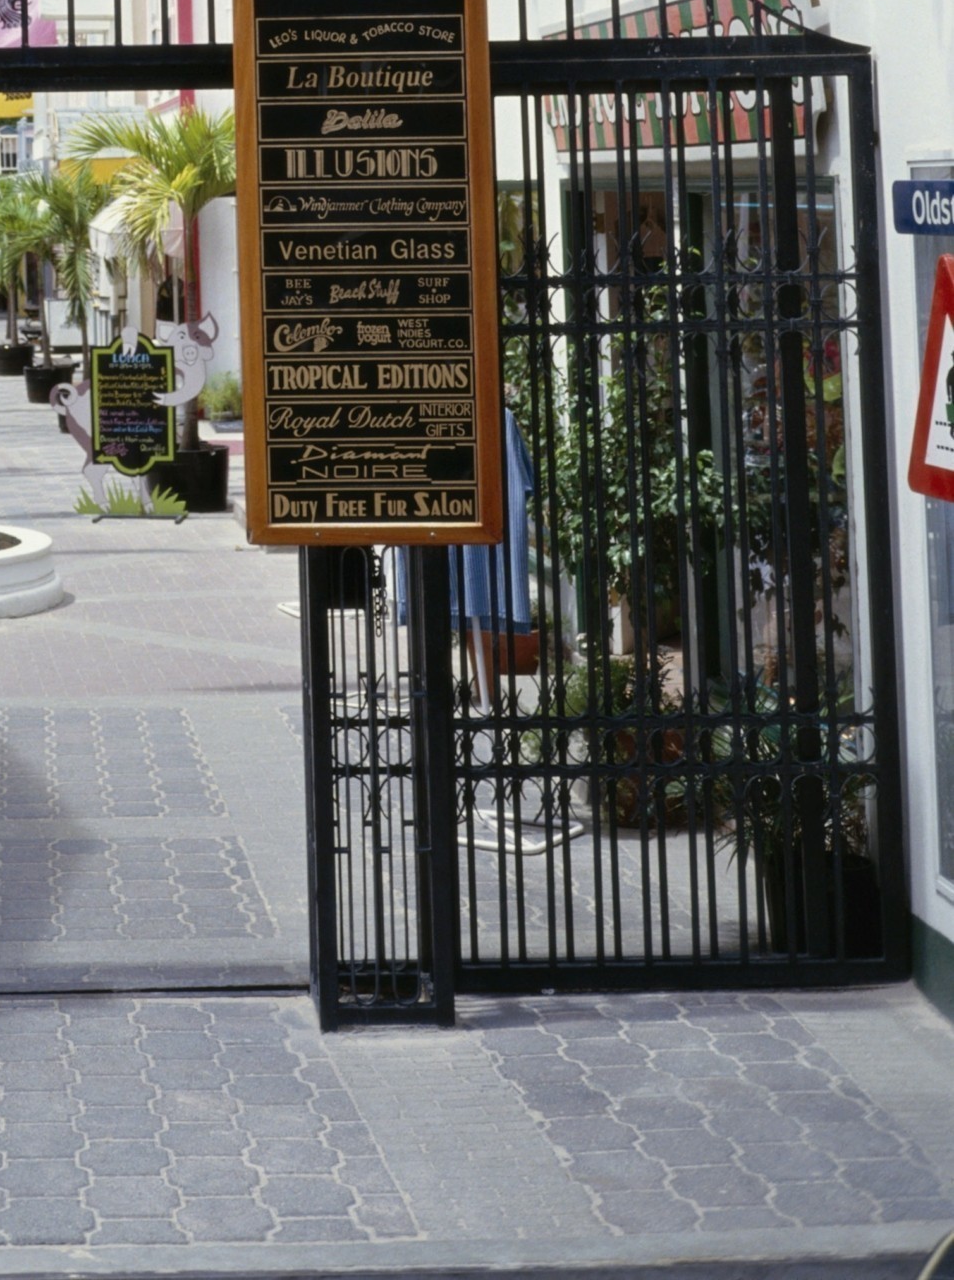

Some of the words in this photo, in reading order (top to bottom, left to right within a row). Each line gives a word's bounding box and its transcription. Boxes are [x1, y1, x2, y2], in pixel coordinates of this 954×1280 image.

[268, 28, 298, 49] LEO'S
[304, 29, 347, 44] LIQUOR
[350, 34, 358, 44] &
[362, 22, 414, 42] TOBACCO
[418, 25, 456, 43] STORE
[286, 66, 318, 89] La
[327, 65, 434, 93] Boutique
[285, 148, 439, 178] ILLUSIONS
[297, 197, 368, 220] Windjammer
[369, 197, 414, 216] Clothing
[416, 197, 466, 221] Company
[279, 240, 378, 261] Venetian
[390, 238, 456, 260] Glass
[285, 278, 312, 289] BEE
[417, 277, 450, 288] SURF
[329, 280, 367, 304] Beach
[368, 278, 401, 304] Stuff
[418, 293, 451, 304] SHOP
[281, 294, 314, 306] JAY'S
[357, 321, 391, 334] frozen
[397, 318, 430, 328] WEST
[273, 318, 344, 352] Colombo
[357, 332, 392, 346] yogurt
[397, 328, 432, 338] INDIES
[268, 364, 368, 390] TROPICAL
[377, 363, 469, 389] EDITIONS
[419, 402, 471, 417] INTERIOR
[268, 406, 343, 437] Royal
[347, 405, 417, 429] Dutch
[425, 422, 466, 437] GIFTS
[302, 465, 428, 479] NOIRE
